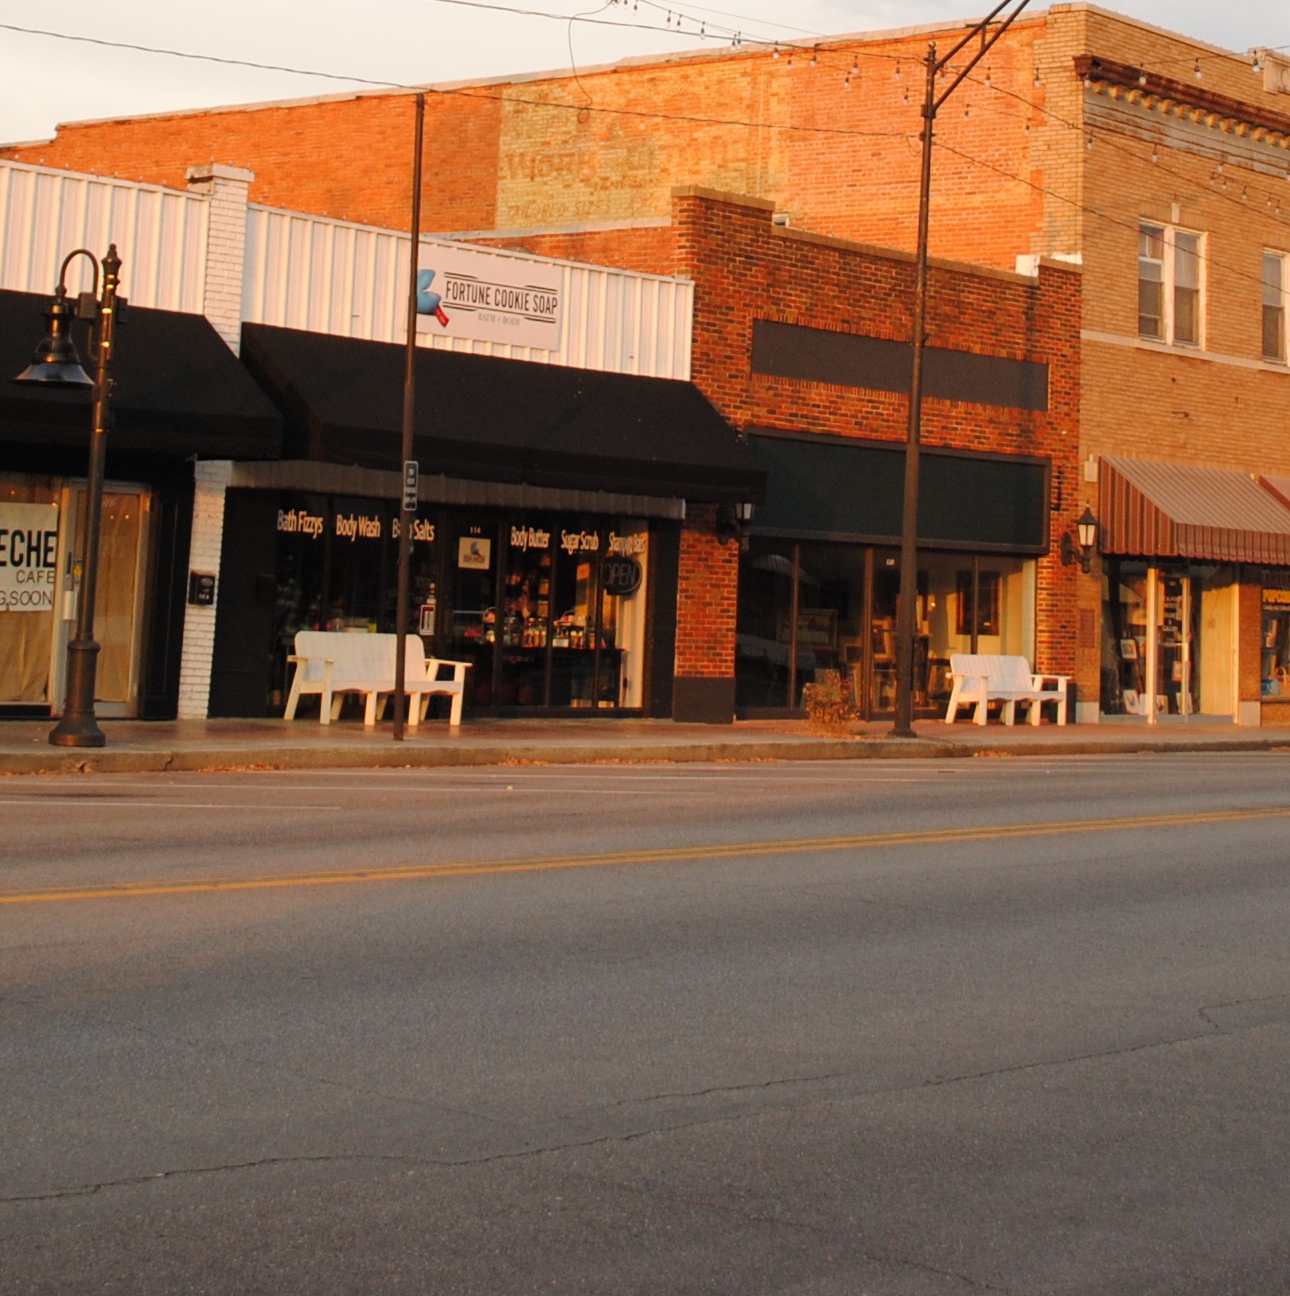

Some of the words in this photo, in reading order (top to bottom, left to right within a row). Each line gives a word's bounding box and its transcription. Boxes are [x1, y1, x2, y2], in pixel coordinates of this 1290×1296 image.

[445, 280, 491, 305] FORTUNE
[494, 288, 530, 311] COOKIE
[533, 295, 558, 315] SOAP
[277, 509, 297, 532] Bath
[298, 510, 324, 539] Fizzys
[336, 513, 358, 542] Body
[359, 515, 381, 537] Wash
[413, 518, 435, 542] Salts
[510, 525, 528, 552] Body
[561, 529, 580, 555] Sugar
[603, 563, 637, 585] OPEN
[8, 590, 53, 606] SOON
